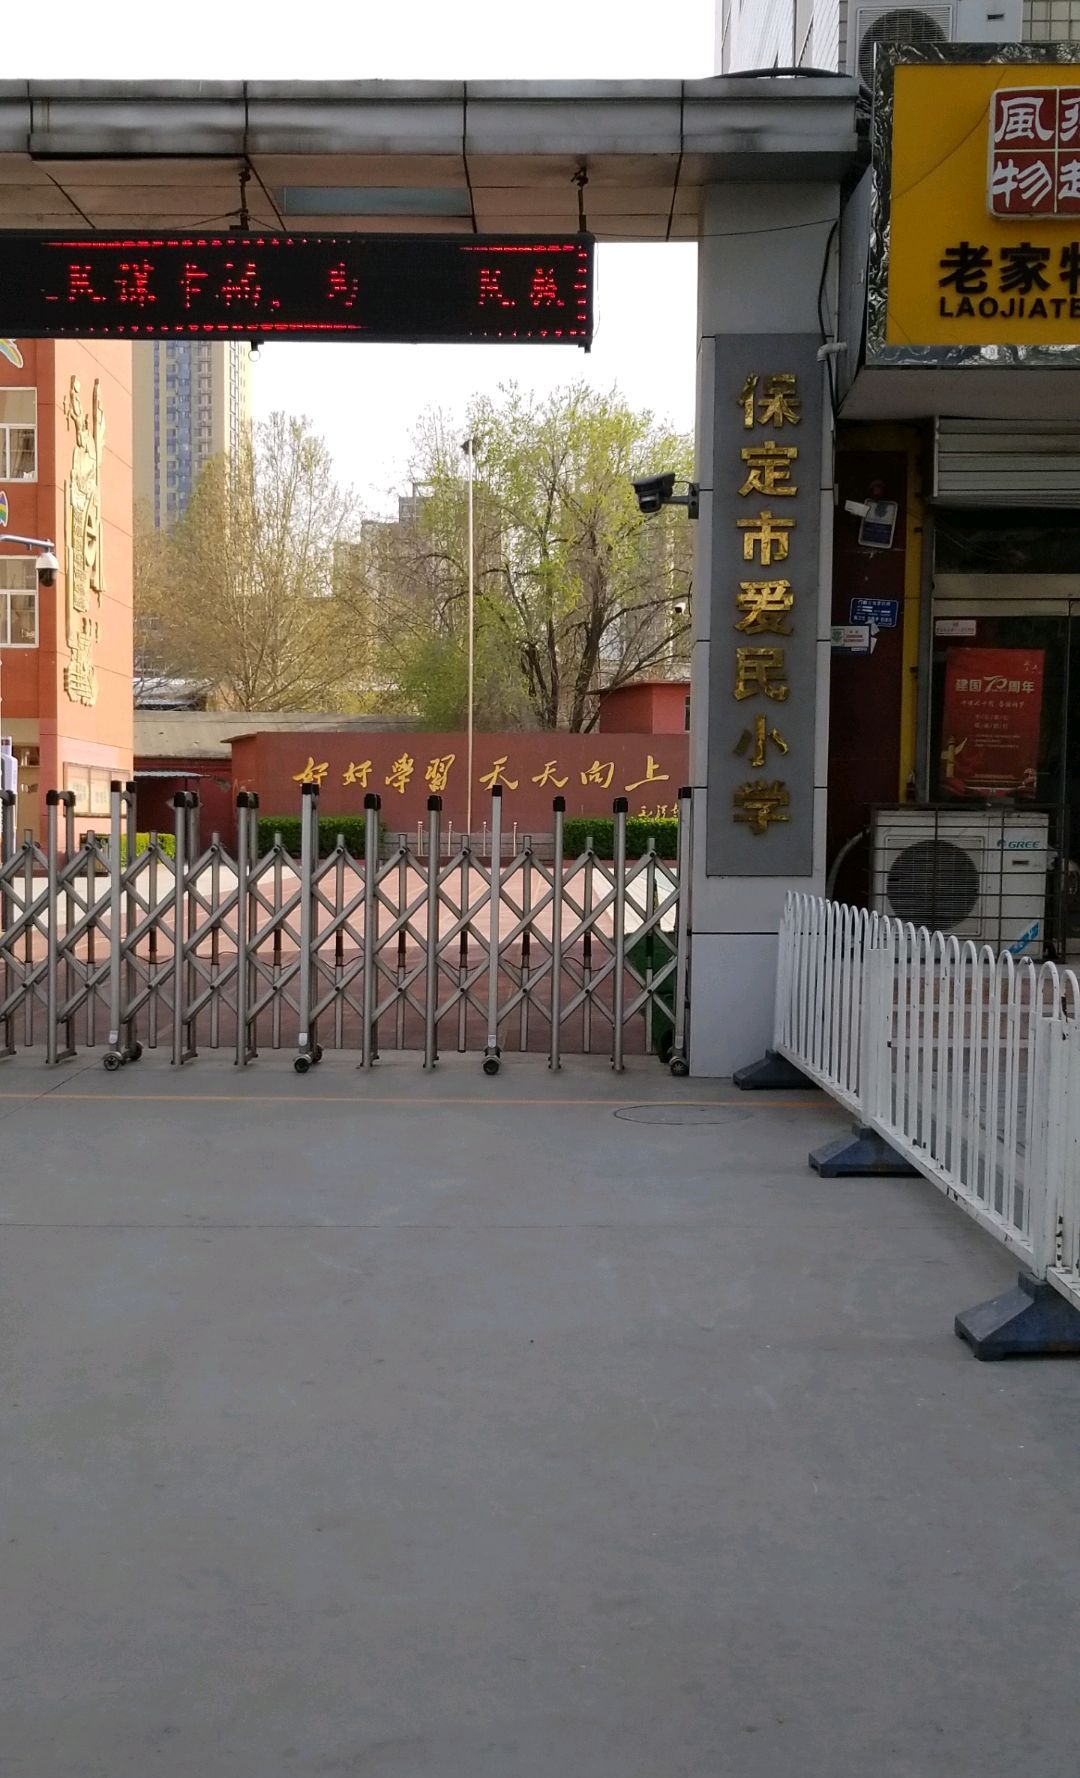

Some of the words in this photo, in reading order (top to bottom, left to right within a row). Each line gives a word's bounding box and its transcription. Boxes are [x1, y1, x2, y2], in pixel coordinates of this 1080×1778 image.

[732, 371, 802, 836] 保定市爱民小学
[479, 755, 670, 792] 天天向上
[1008, 840, 1040, 849] GREE
